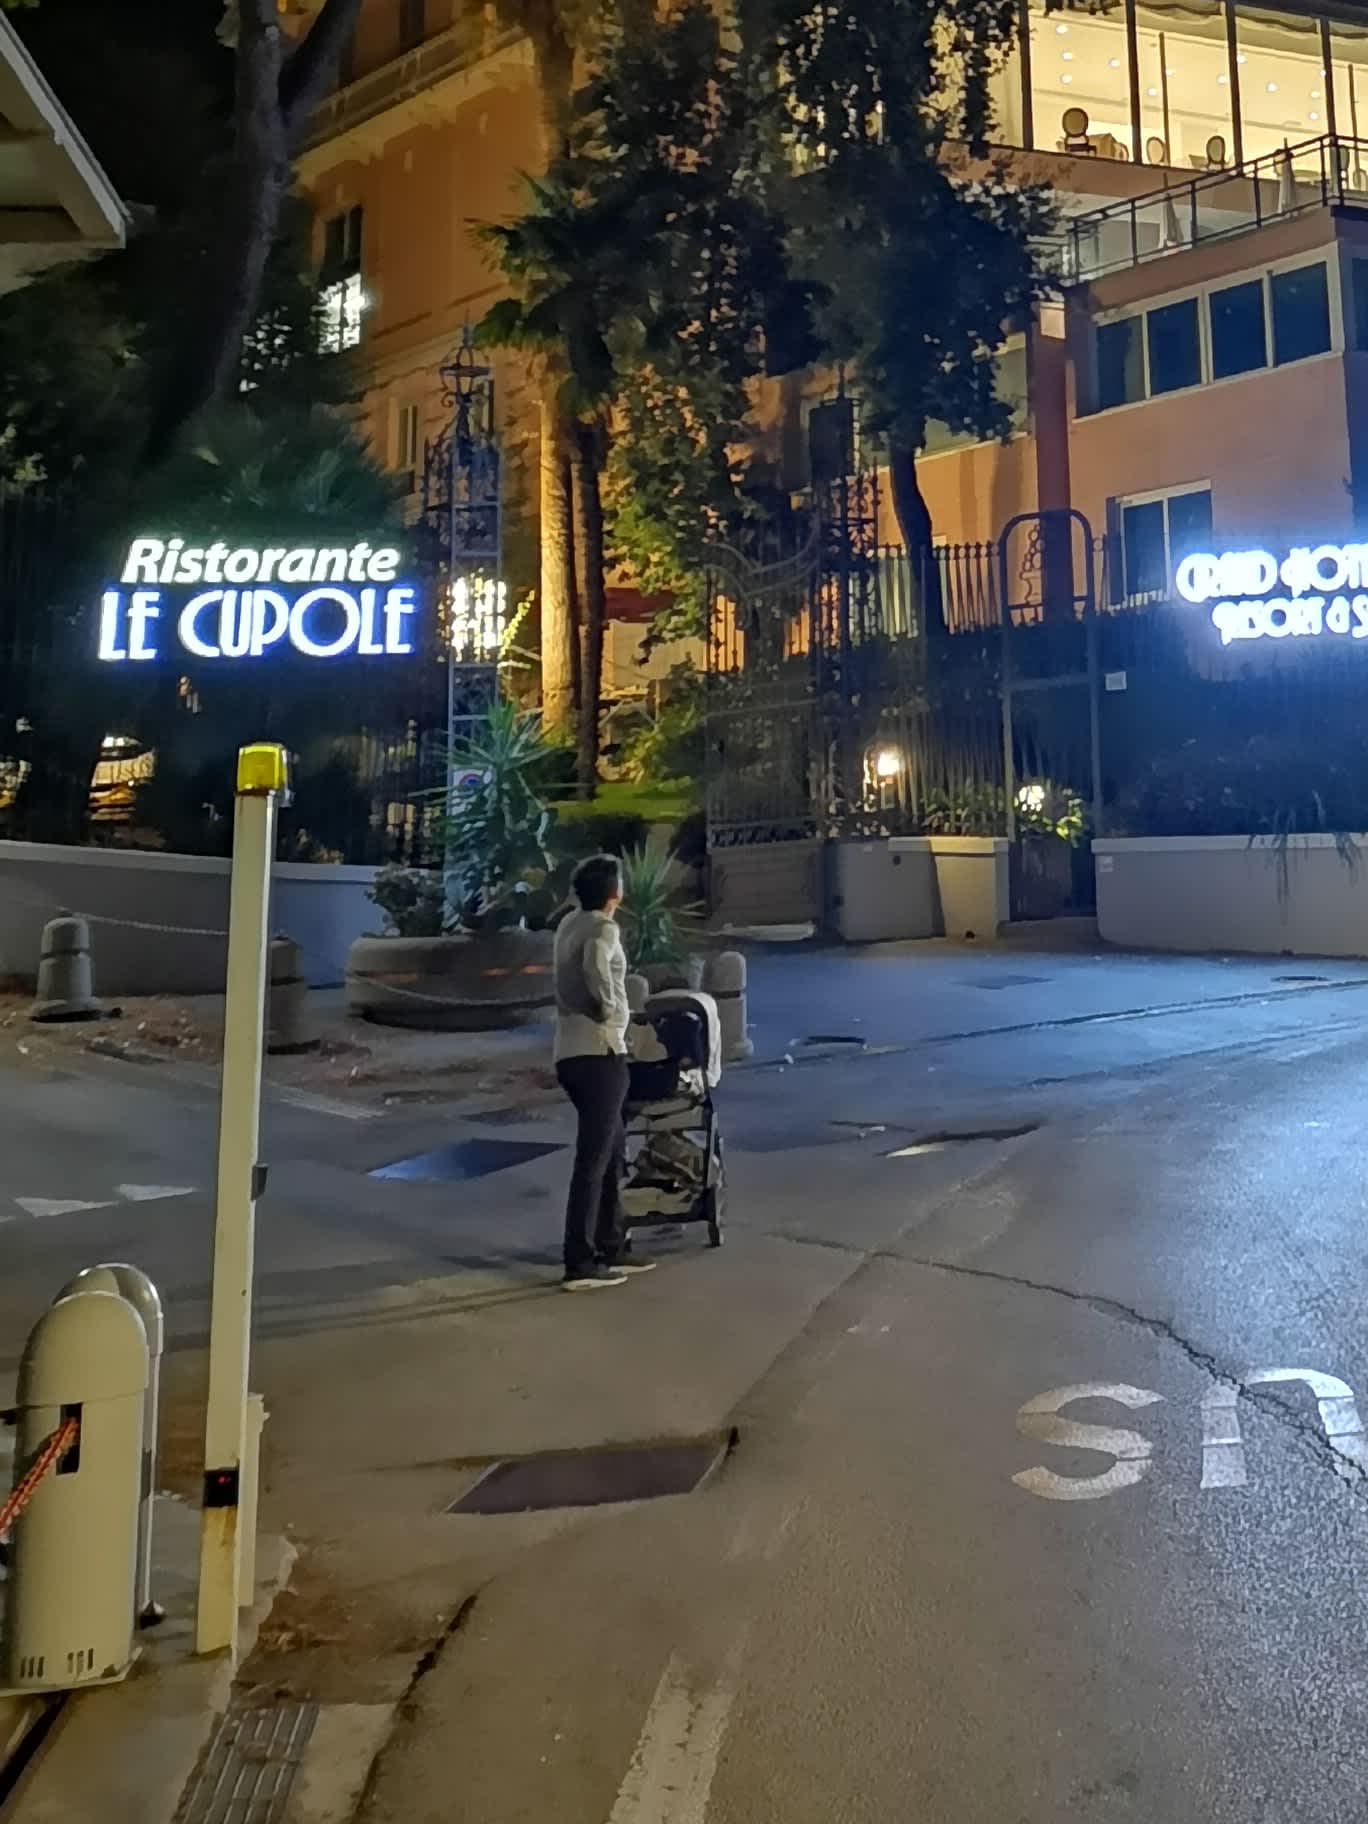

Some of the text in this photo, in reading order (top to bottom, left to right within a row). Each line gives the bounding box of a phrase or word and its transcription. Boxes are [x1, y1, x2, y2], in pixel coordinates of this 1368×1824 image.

[120, 535, 401, 584] Ristorante
[1175, 549, 1278, 603] GRAND
[97, 586, 416, 662] LE CUPOLE
